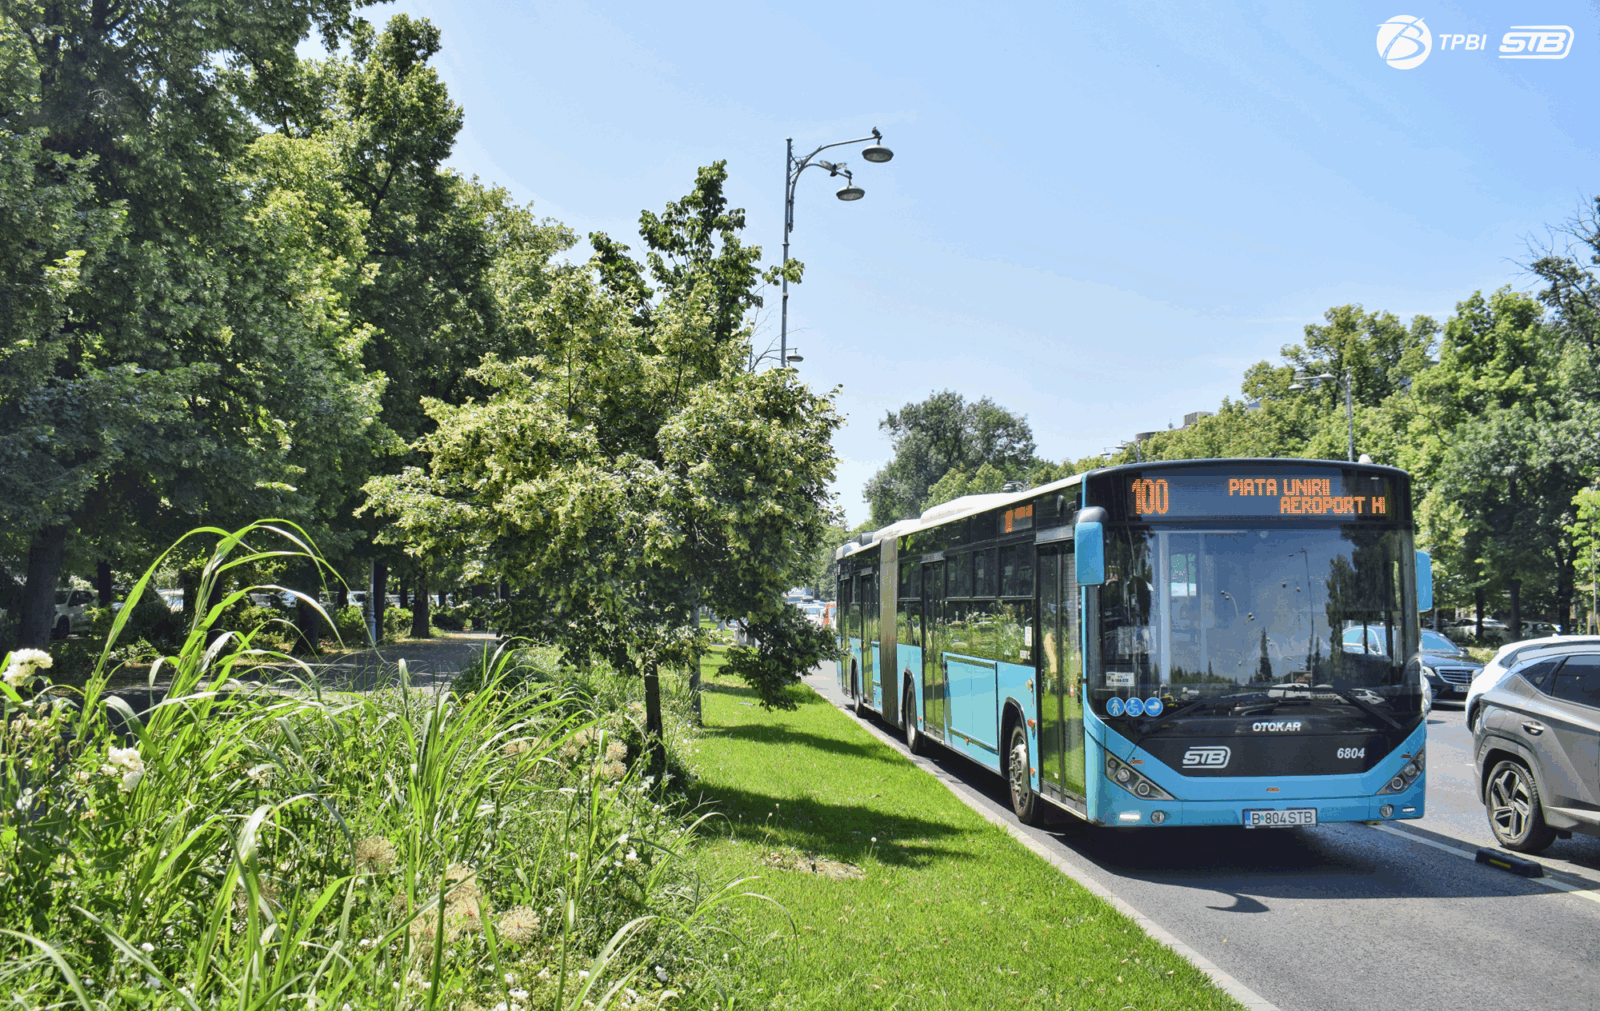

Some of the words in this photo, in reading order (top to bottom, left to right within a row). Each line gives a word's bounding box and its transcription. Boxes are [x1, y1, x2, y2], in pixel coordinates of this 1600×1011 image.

[1228, 478, 1278, 496] PIATA
[1283, 478, 1330, 496] UNIRII
[1131, 478, 1169, 515] 100
[1280, 496, 1366, 514] AEROPORT
[1252, 722, 1302, 732] OTOKAR
[1182, 750, 1227, 765] STB
[1336, 747, 1366, 759] 6804
